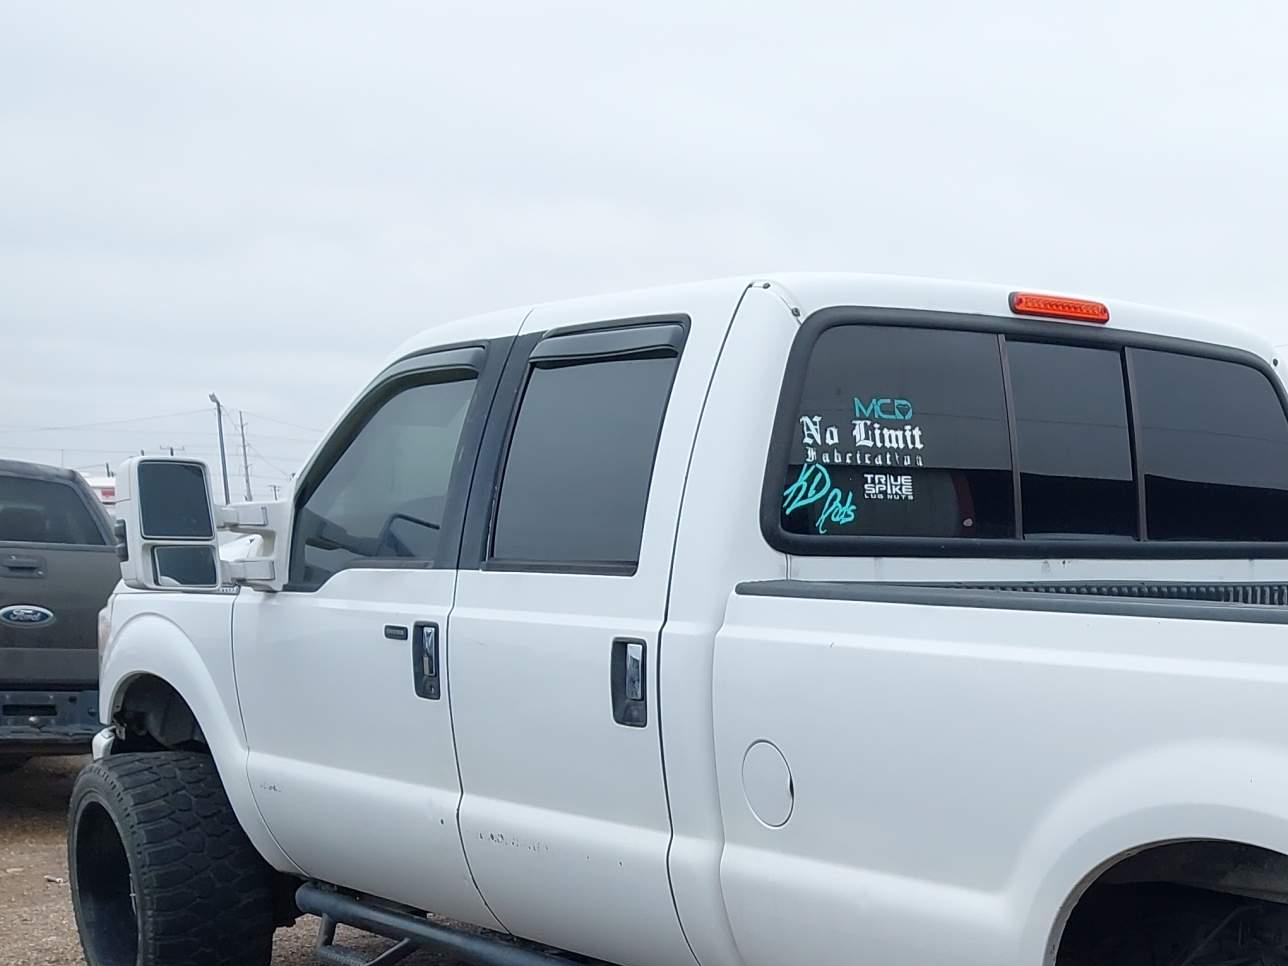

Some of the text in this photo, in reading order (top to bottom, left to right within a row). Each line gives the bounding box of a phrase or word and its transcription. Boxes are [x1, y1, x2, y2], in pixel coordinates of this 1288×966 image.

[800, 415, 924, 449] No Limit
[863, 474, 913, 485] TRUE
[863, 482, 914, 495] SPIKE
